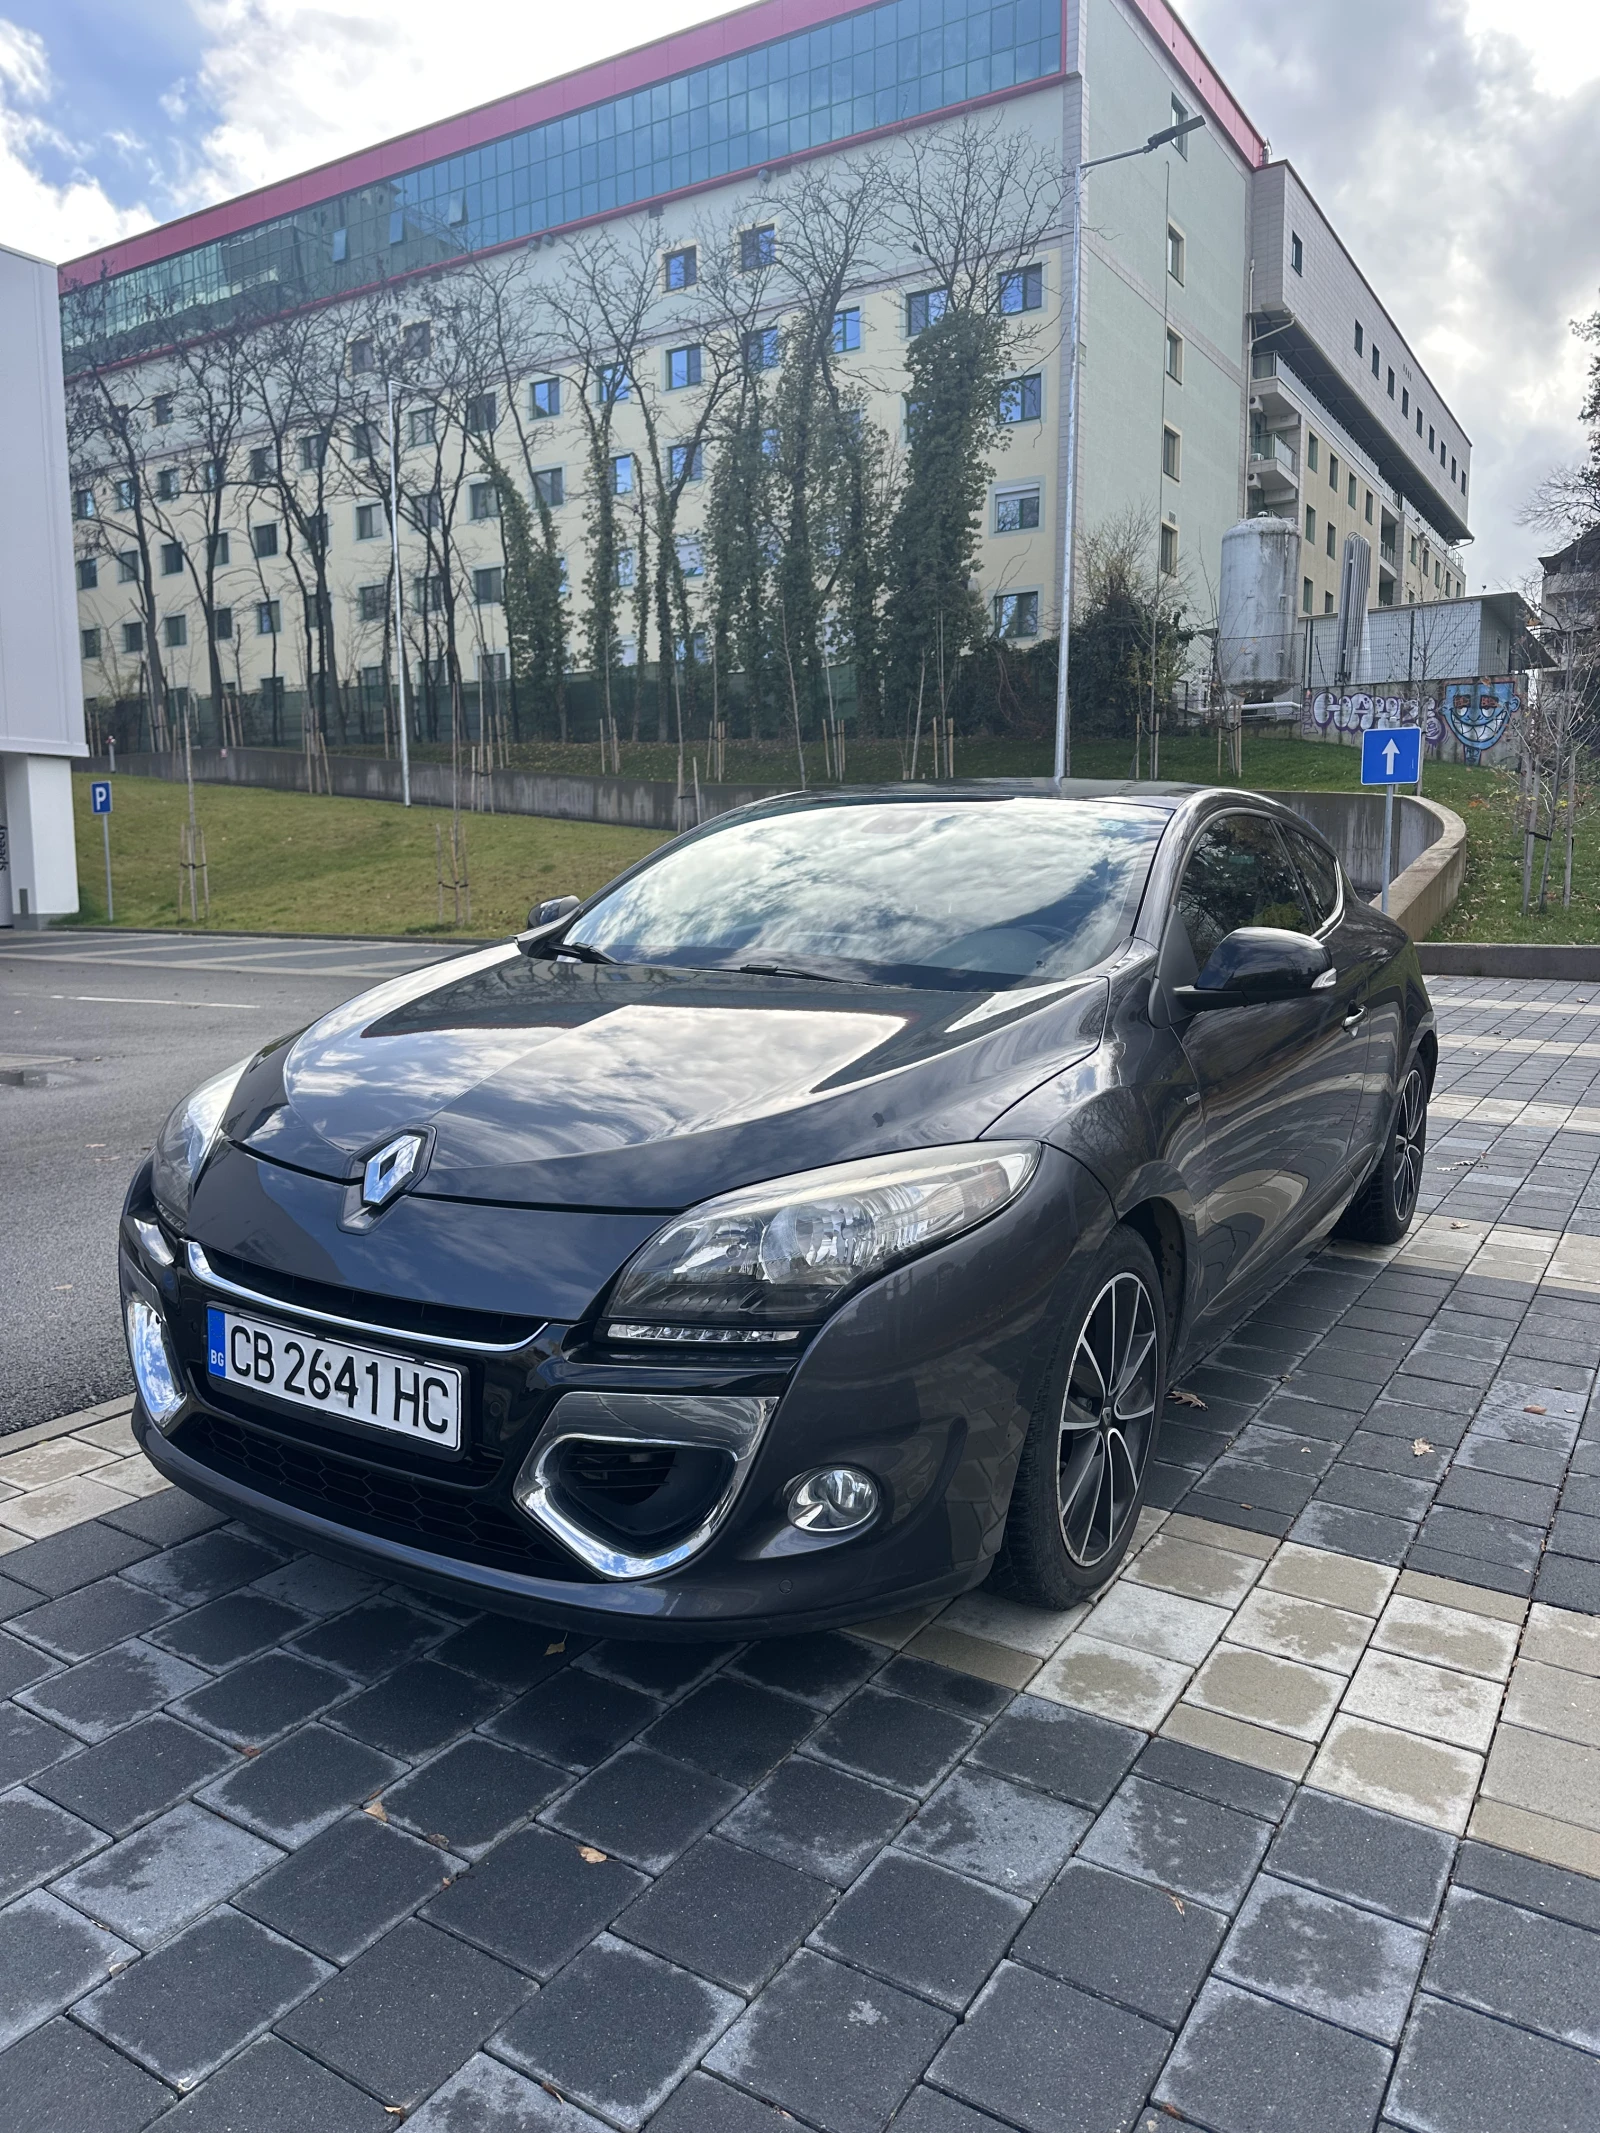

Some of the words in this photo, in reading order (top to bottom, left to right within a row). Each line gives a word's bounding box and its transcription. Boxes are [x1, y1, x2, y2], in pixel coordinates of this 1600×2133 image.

[95, 786, 107, 811] P
[210, 1350, 225, 1367] BG
[230, 1325, 275, 1384] CB
[283, 1341, 380, 1416] 2641
[393, 1365, 449, 1434] HC
